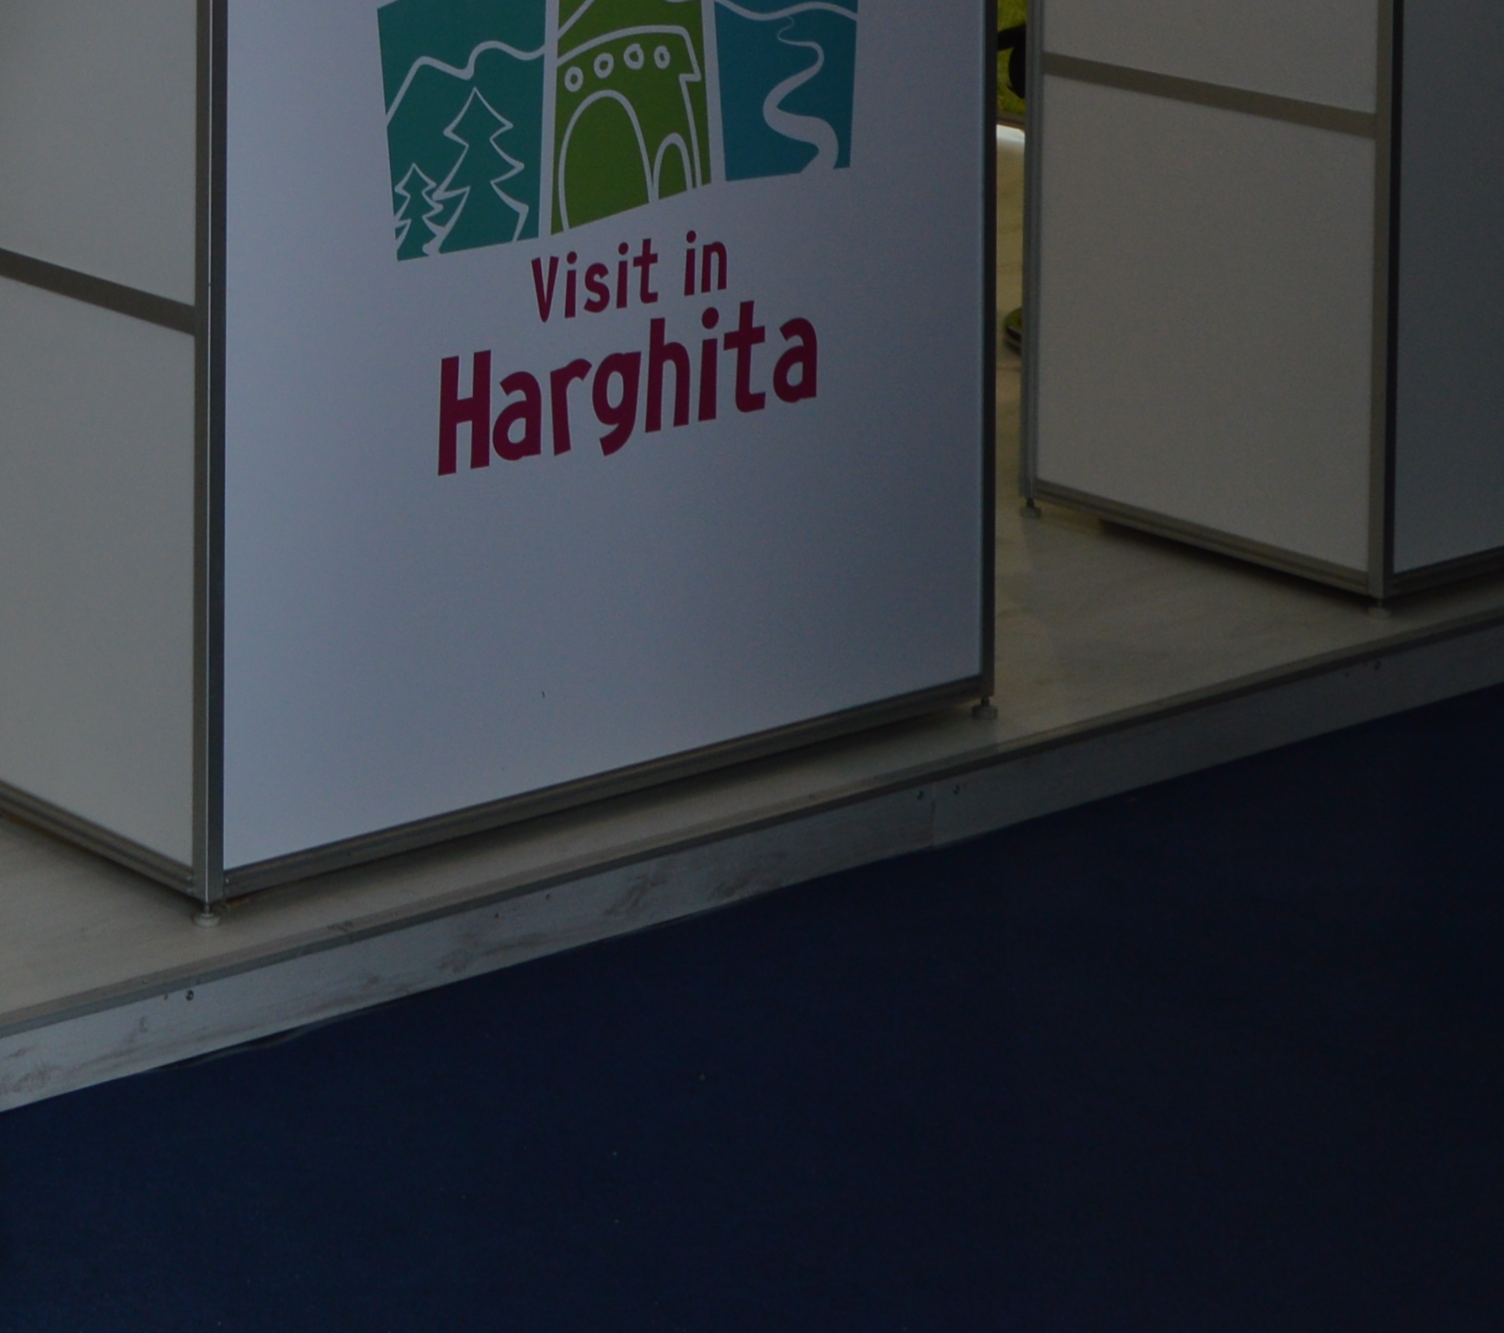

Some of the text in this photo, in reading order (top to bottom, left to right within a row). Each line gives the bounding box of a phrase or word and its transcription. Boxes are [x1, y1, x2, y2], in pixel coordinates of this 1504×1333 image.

[530, 229, 728, 323] Visit in
[437, 299, 818, 476] Harghita
